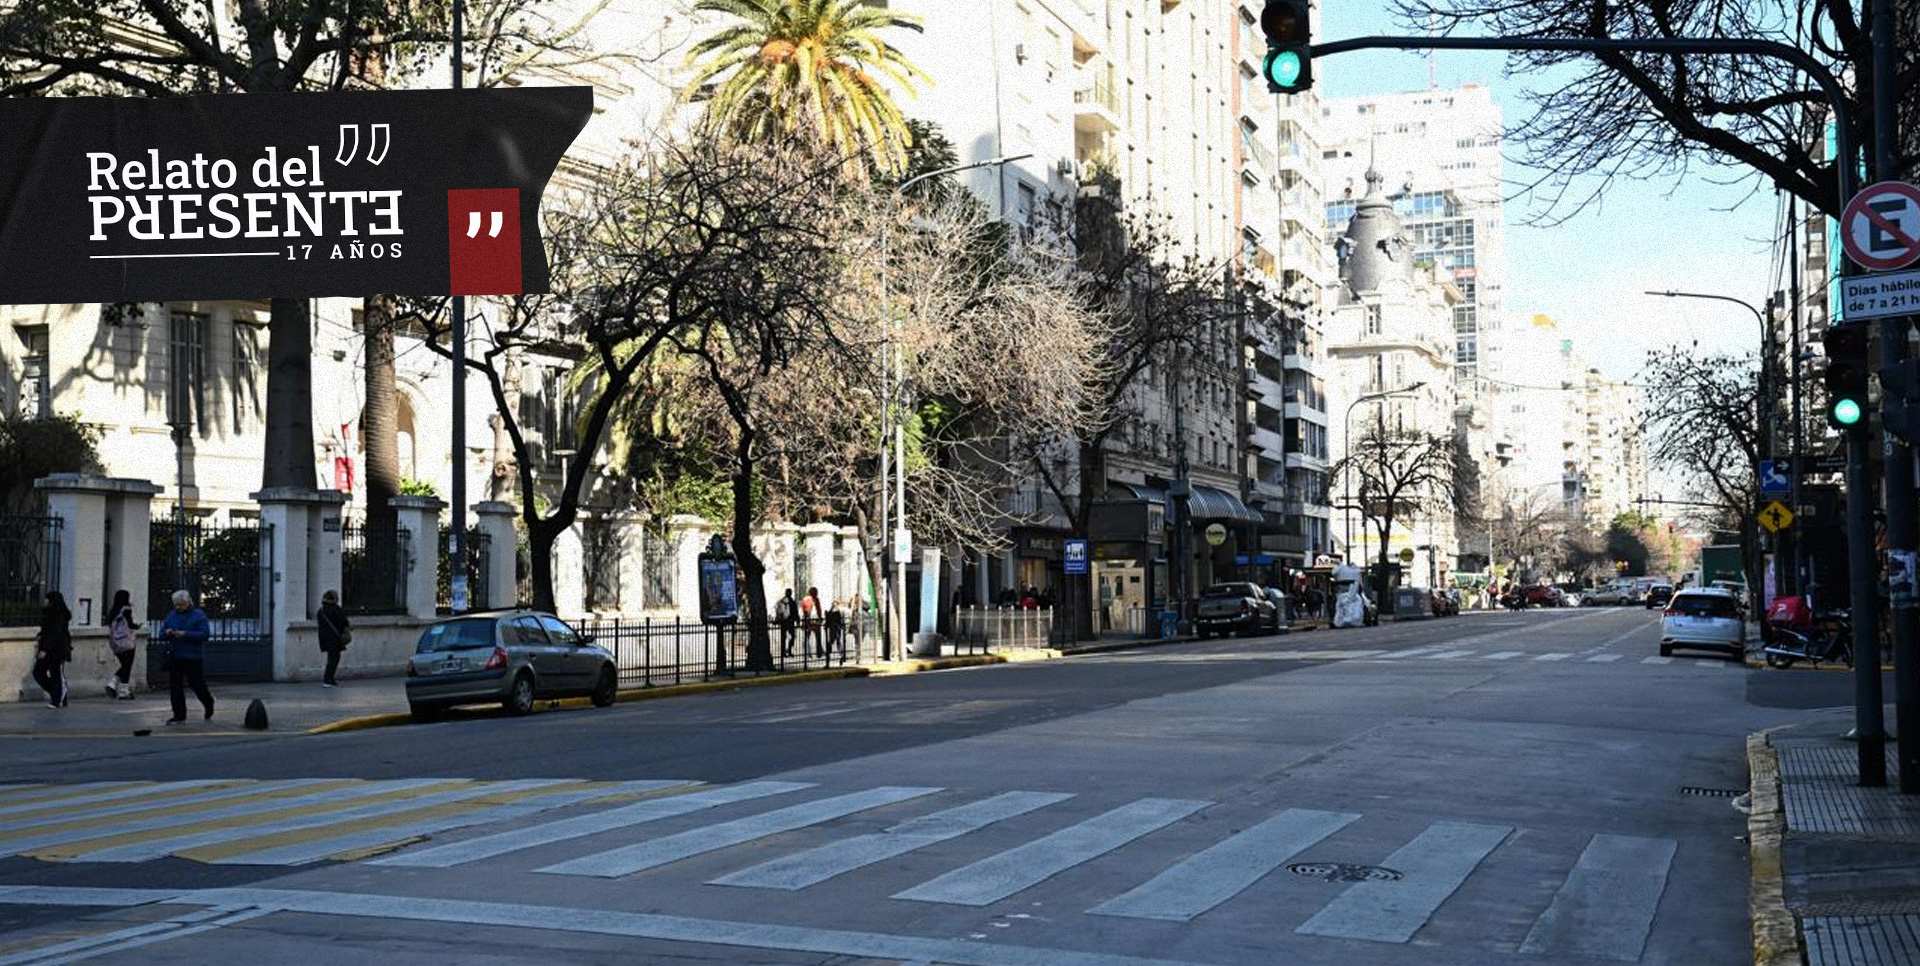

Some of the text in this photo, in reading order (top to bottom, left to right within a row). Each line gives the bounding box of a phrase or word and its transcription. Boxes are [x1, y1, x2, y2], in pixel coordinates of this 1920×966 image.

[1849, 301, 1865, 311] de
[1869, 298, 1879, 309] 7
[1880, 299, 1888, 308] a
[1891, 295, 1905, 306] 21
